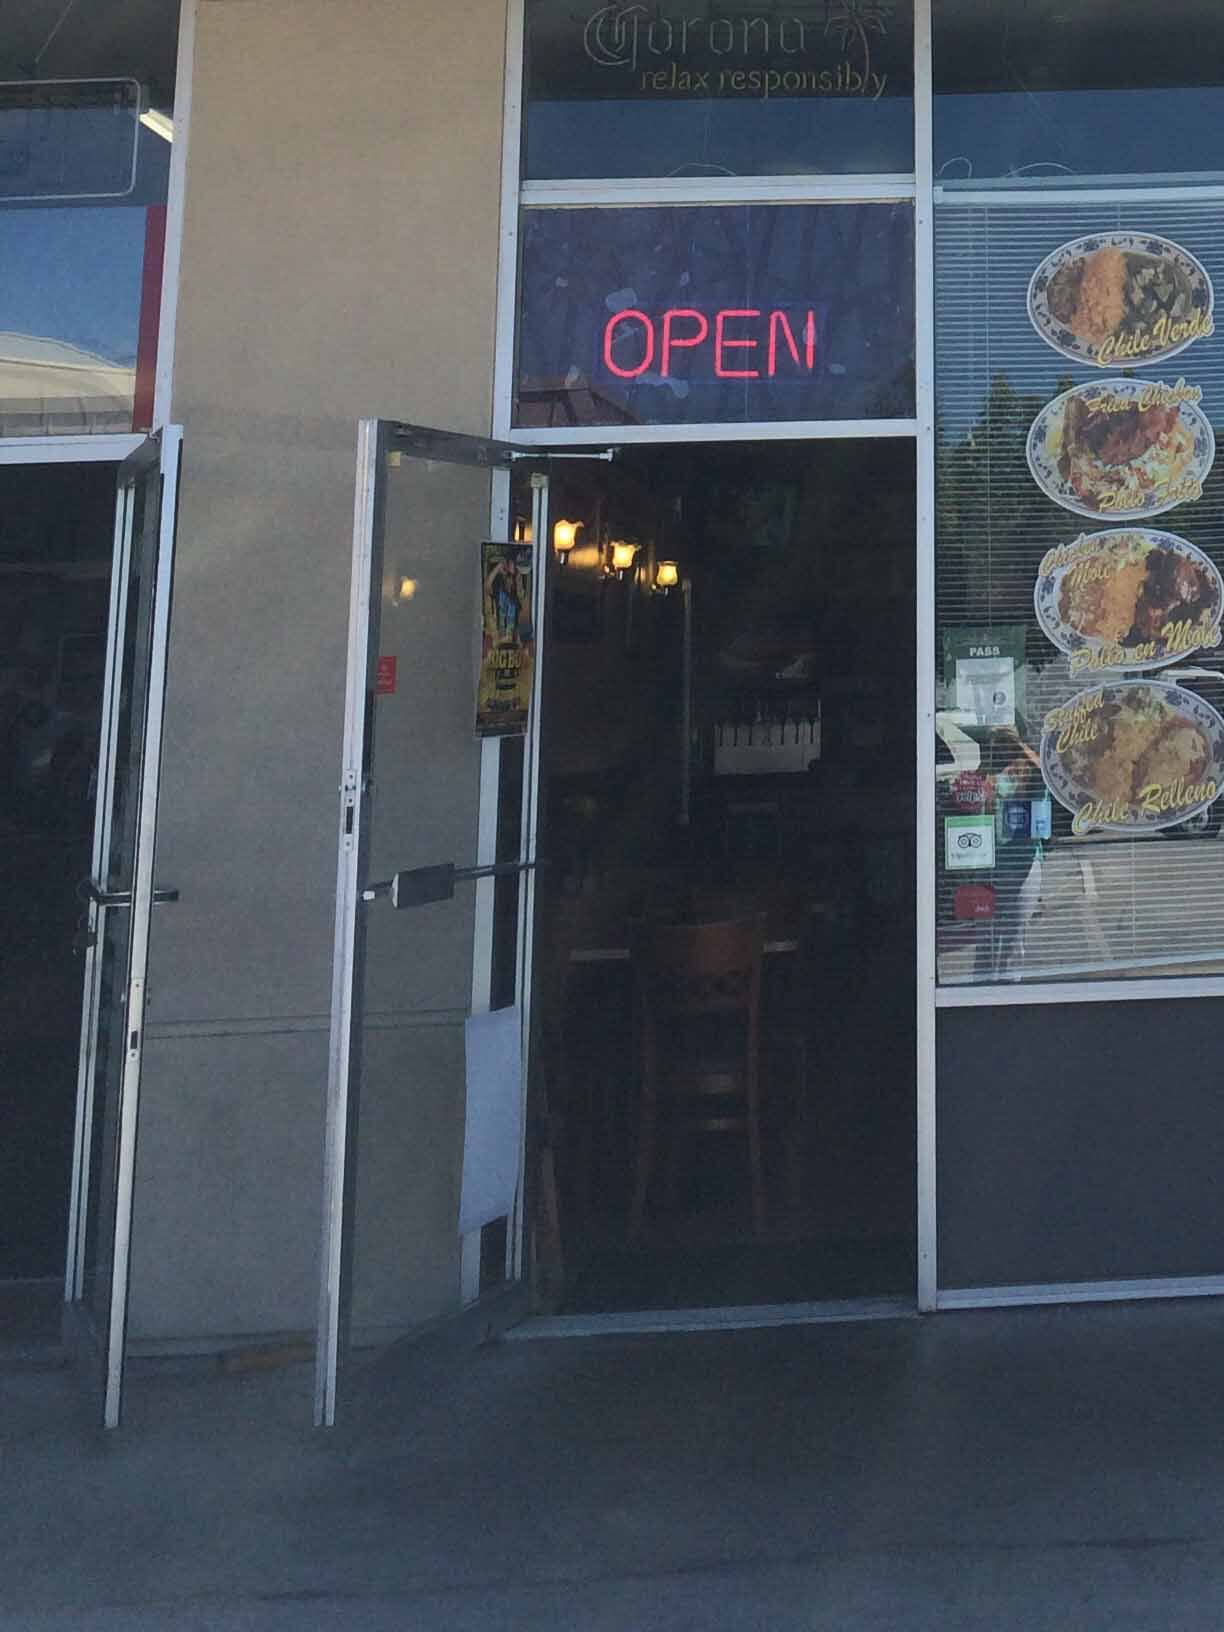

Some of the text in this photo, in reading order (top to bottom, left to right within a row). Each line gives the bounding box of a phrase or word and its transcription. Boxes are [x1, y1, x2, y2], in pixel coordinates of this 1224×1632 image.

[584, 5, 805, 70] Corona
[640, 62, 888, 101] relax responsibly
[603, 309, 816, 379] OPEN
[1098, 306, 1214, 365] Chile Verde
[969, 646, 1001, 657] PASS
[1136, 776, 1217, 814] Relleno
